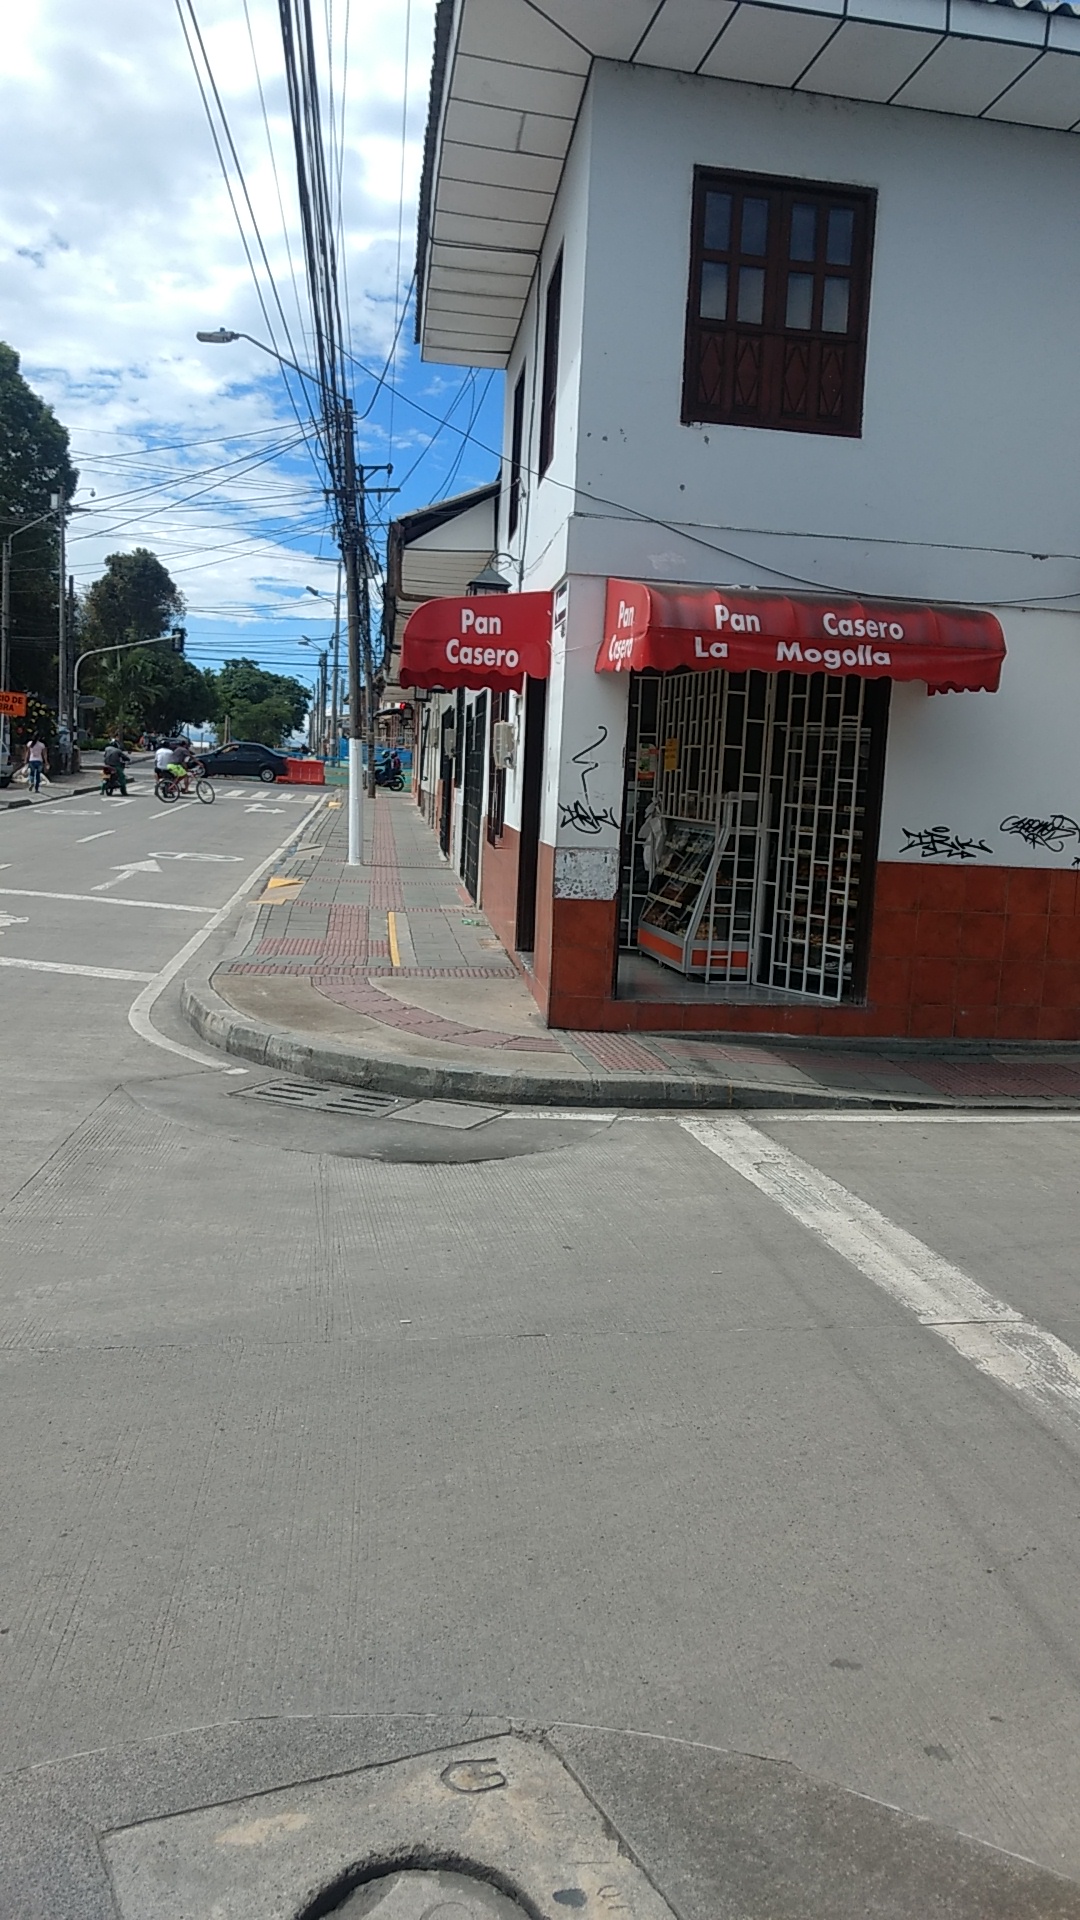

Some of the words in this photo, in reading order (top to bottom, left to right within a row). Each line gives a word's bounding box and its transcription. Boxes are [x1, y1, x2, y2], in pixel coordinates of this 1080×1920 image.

[461, 608, 502, 635] Pan
[617, 600, 635, 629] Pan
[714, 604, 761, 632] Pan
[822, 612, 904, 640] Casero
[445, 638, 519, 668] Casero
[694, 636, 729, 658] La
[776, 641, 891, 669] Mogolla
[12, 696, 24, 704] DE
